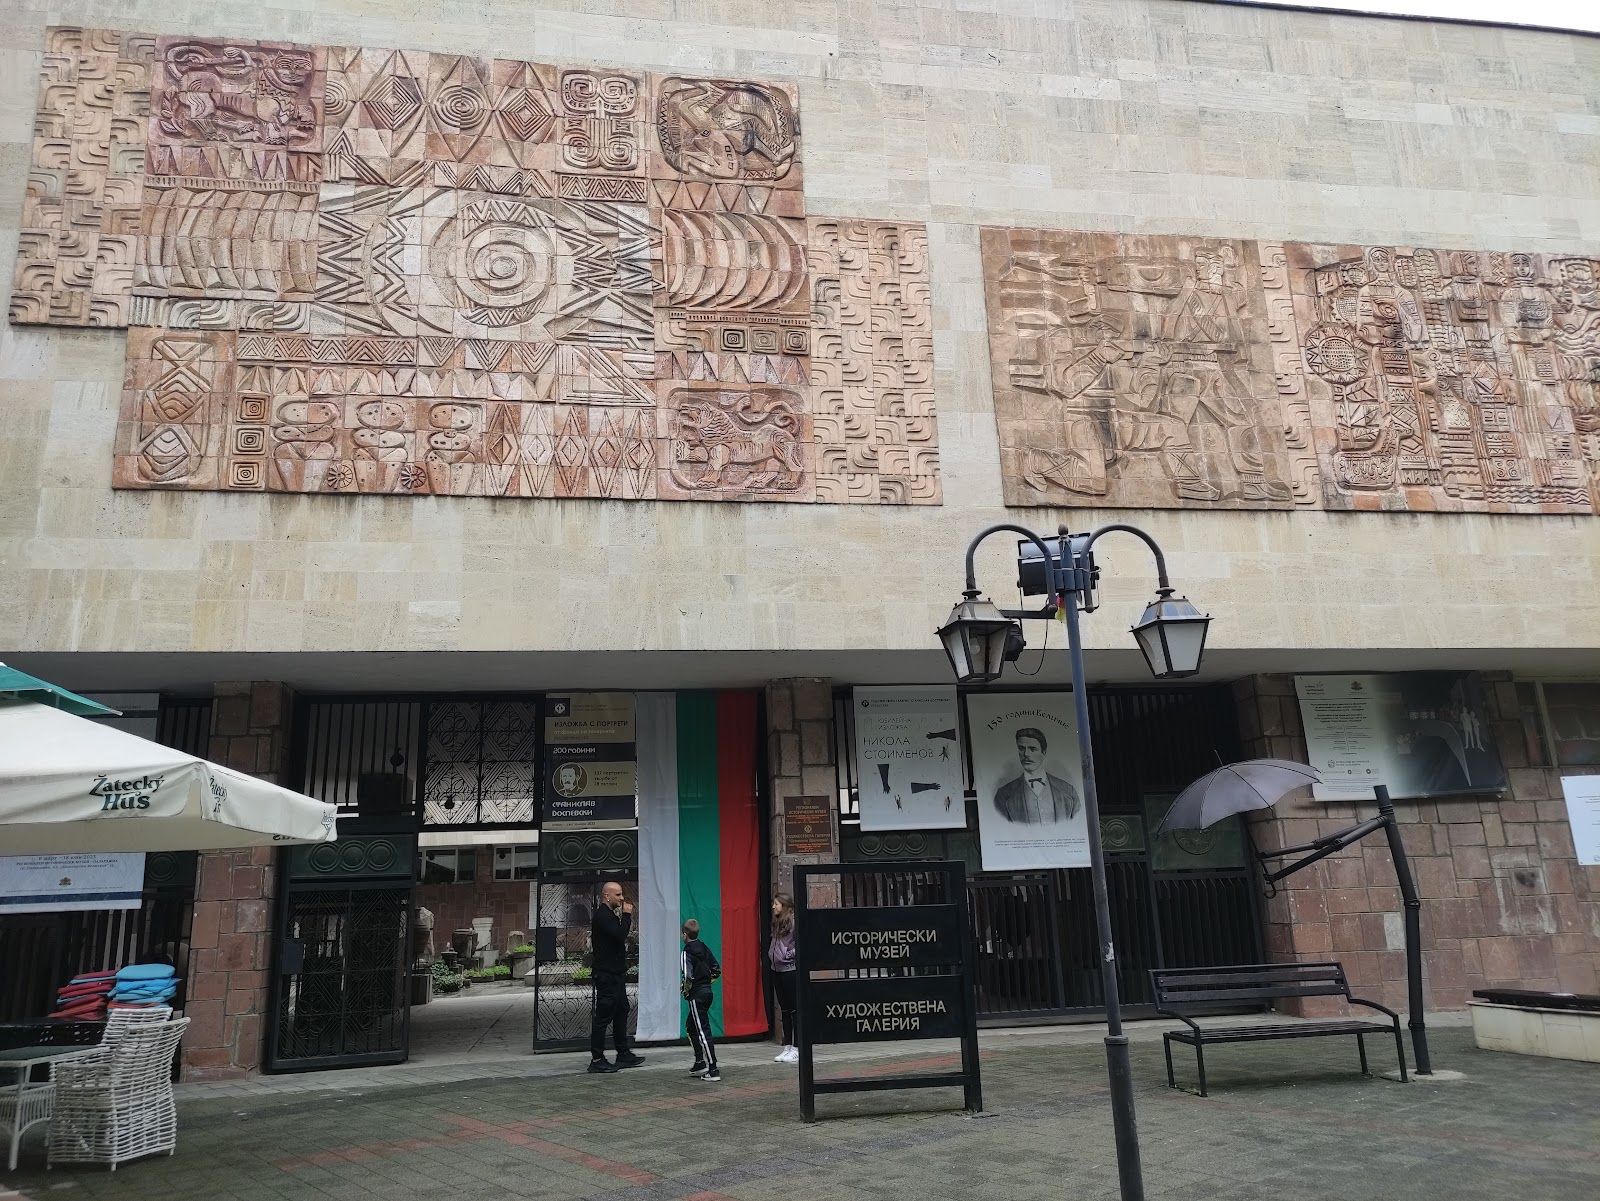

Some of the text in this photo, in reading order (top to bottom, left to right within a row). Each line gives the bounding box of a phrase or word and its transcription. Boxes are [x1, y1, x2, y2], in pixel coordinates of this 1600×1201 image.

[987, 716, 1003, 731] 150
[863, 736, 911, 746] НИКОЛА
[864, 748, 934, 760] СТОИМЕНОВ
[89, 774, 165, 797] Žatecký
[552, 800, 596, 808] СТАНИСЛАВ
[831, 929, 937, 945] ИСТОРИЧЕСКИ
[859, 944, 910, 960] МУЗЕЙ
[826, 1000, 947, 1019] ХУДОЖЕСТВЕНА
[856, 1017, 920, 1033] ГАЛЕРИЯ
